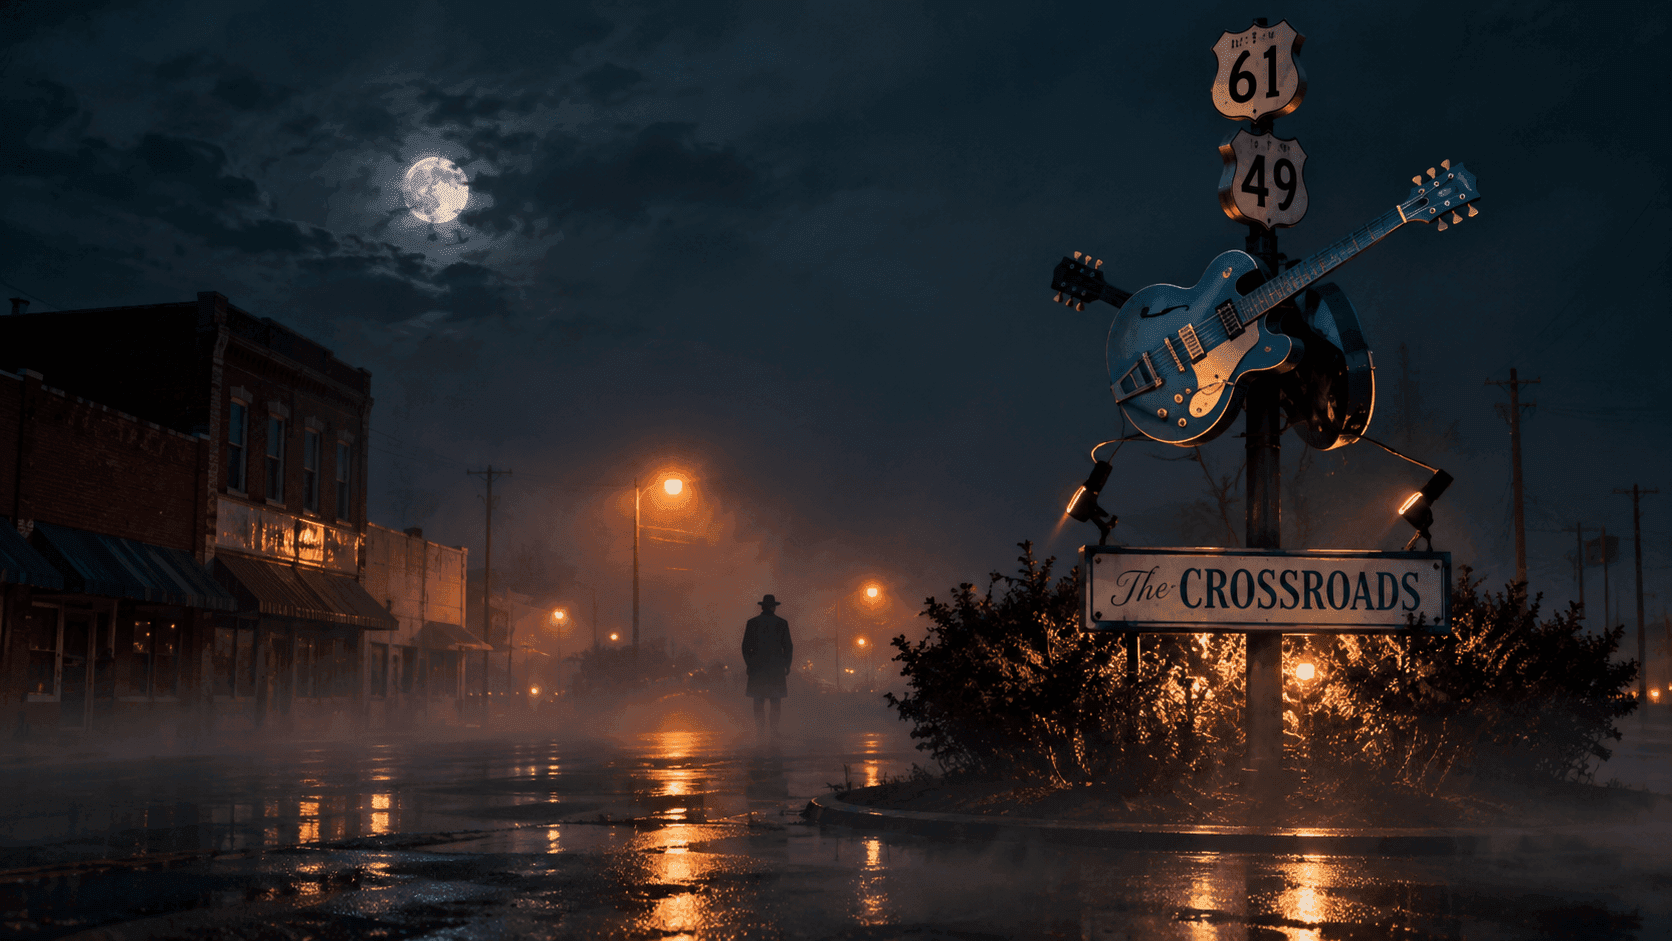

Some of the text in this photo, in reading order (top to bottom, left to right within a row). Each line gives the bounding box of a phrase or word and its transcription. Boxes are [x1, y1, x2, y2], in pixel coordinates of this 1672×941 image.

[1229, 45, 1280, 103] 61
[1241, 154, 1297, 211] 49
[1111, 566, 1421, 611] The CROSSROADS
